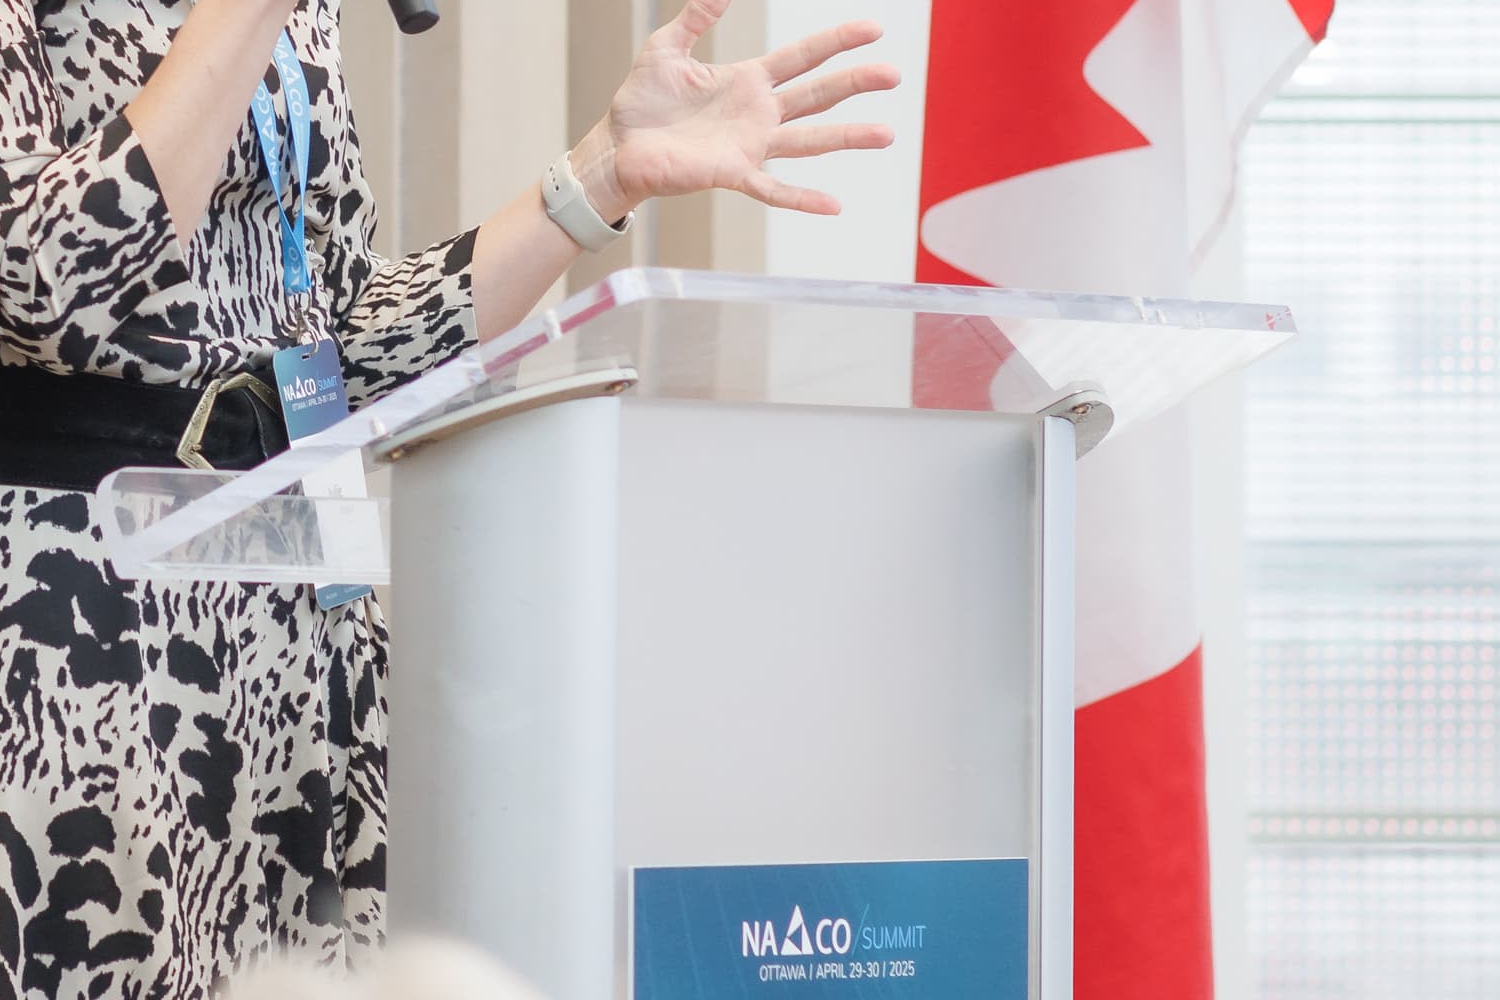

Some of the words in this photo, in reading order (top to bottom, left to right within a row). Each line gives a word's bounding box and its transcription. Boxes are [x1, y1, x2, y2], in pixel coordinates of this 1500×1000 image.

[862, 925, 926, 950] SUMMIT
[759, 965, 807, 982] OTTAWA
[816, 962, 847, 980] APRIL
[849, 961, 880, 979] 29-30
[889, 960, 916, 977] 2025
